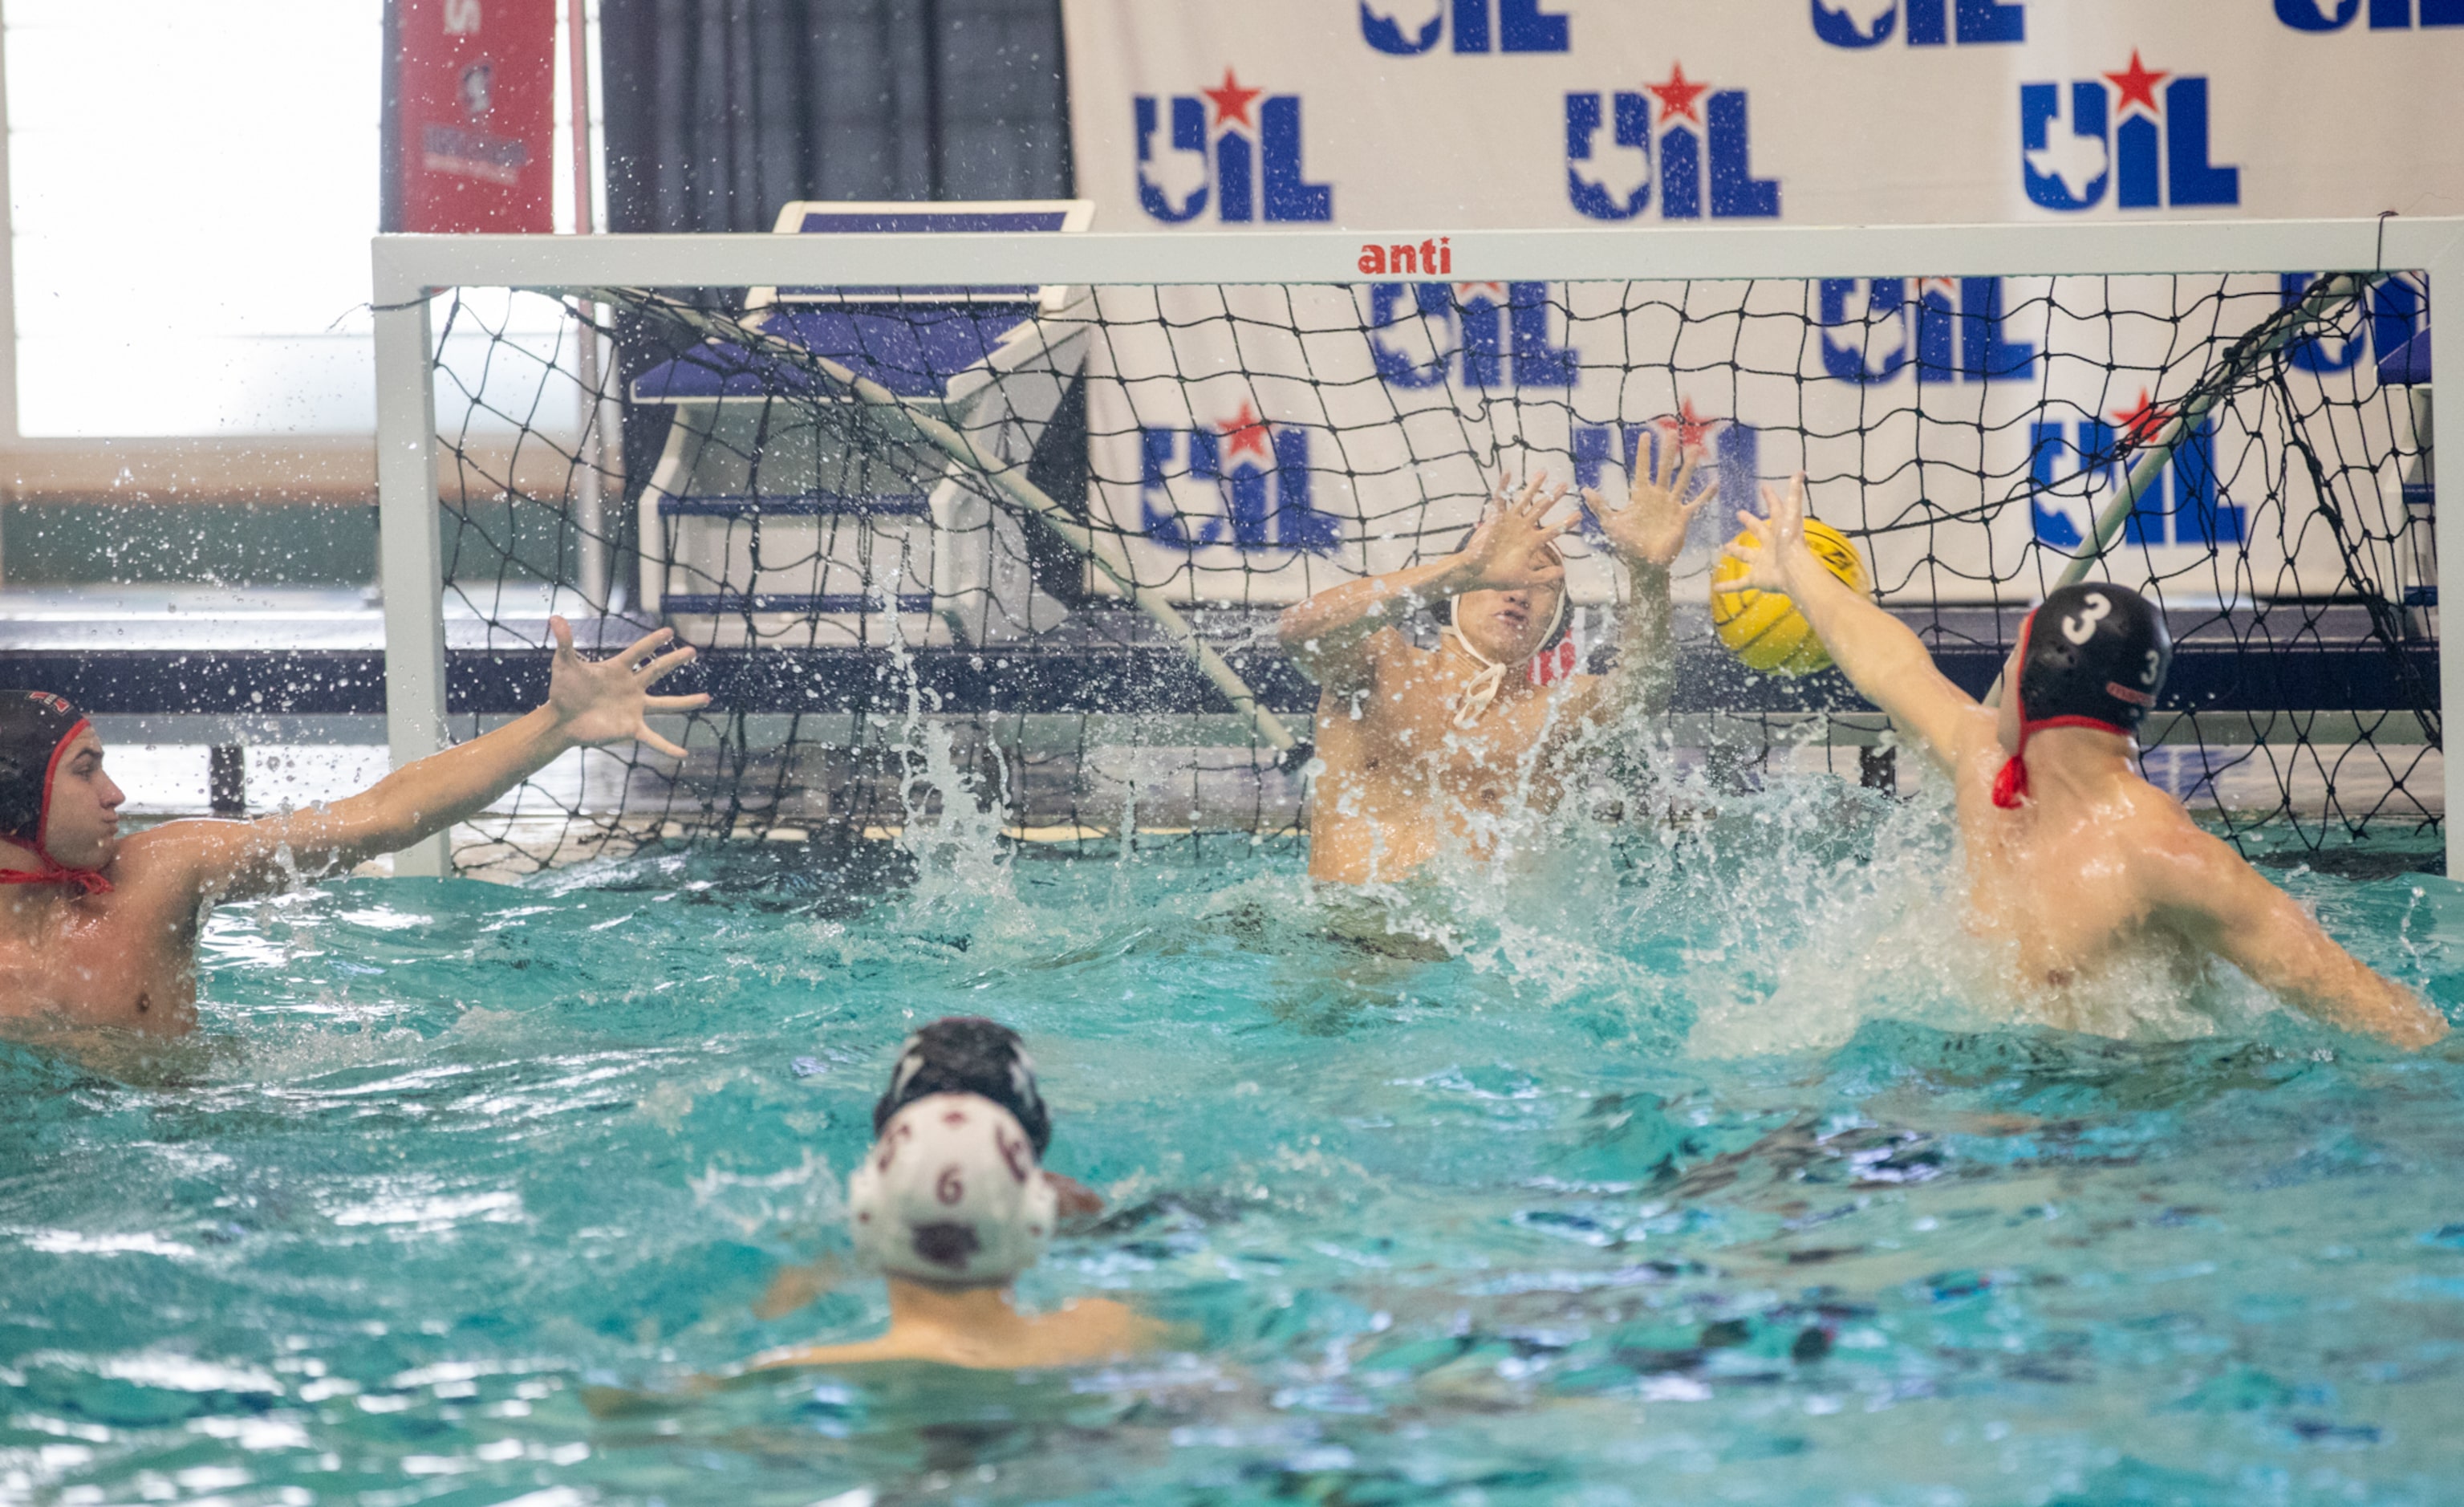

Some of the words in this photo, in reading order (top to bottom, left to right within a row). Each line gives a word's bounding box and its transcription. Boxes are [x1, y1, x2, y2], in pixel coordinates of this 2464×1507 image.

[1135, 92, 1333, 222] UIL
[1565, 88, 1779, 220] UIL
[2020, 74, 2239, 211] UIL
[1358, 237, 1451, 275] anti
[1142, 429, 1342, 552] UIL
[2062, 592, 2112, 644] 3
[2141, 650, 2160, 684] 3
[936, 1167, 964, 1204] 6
